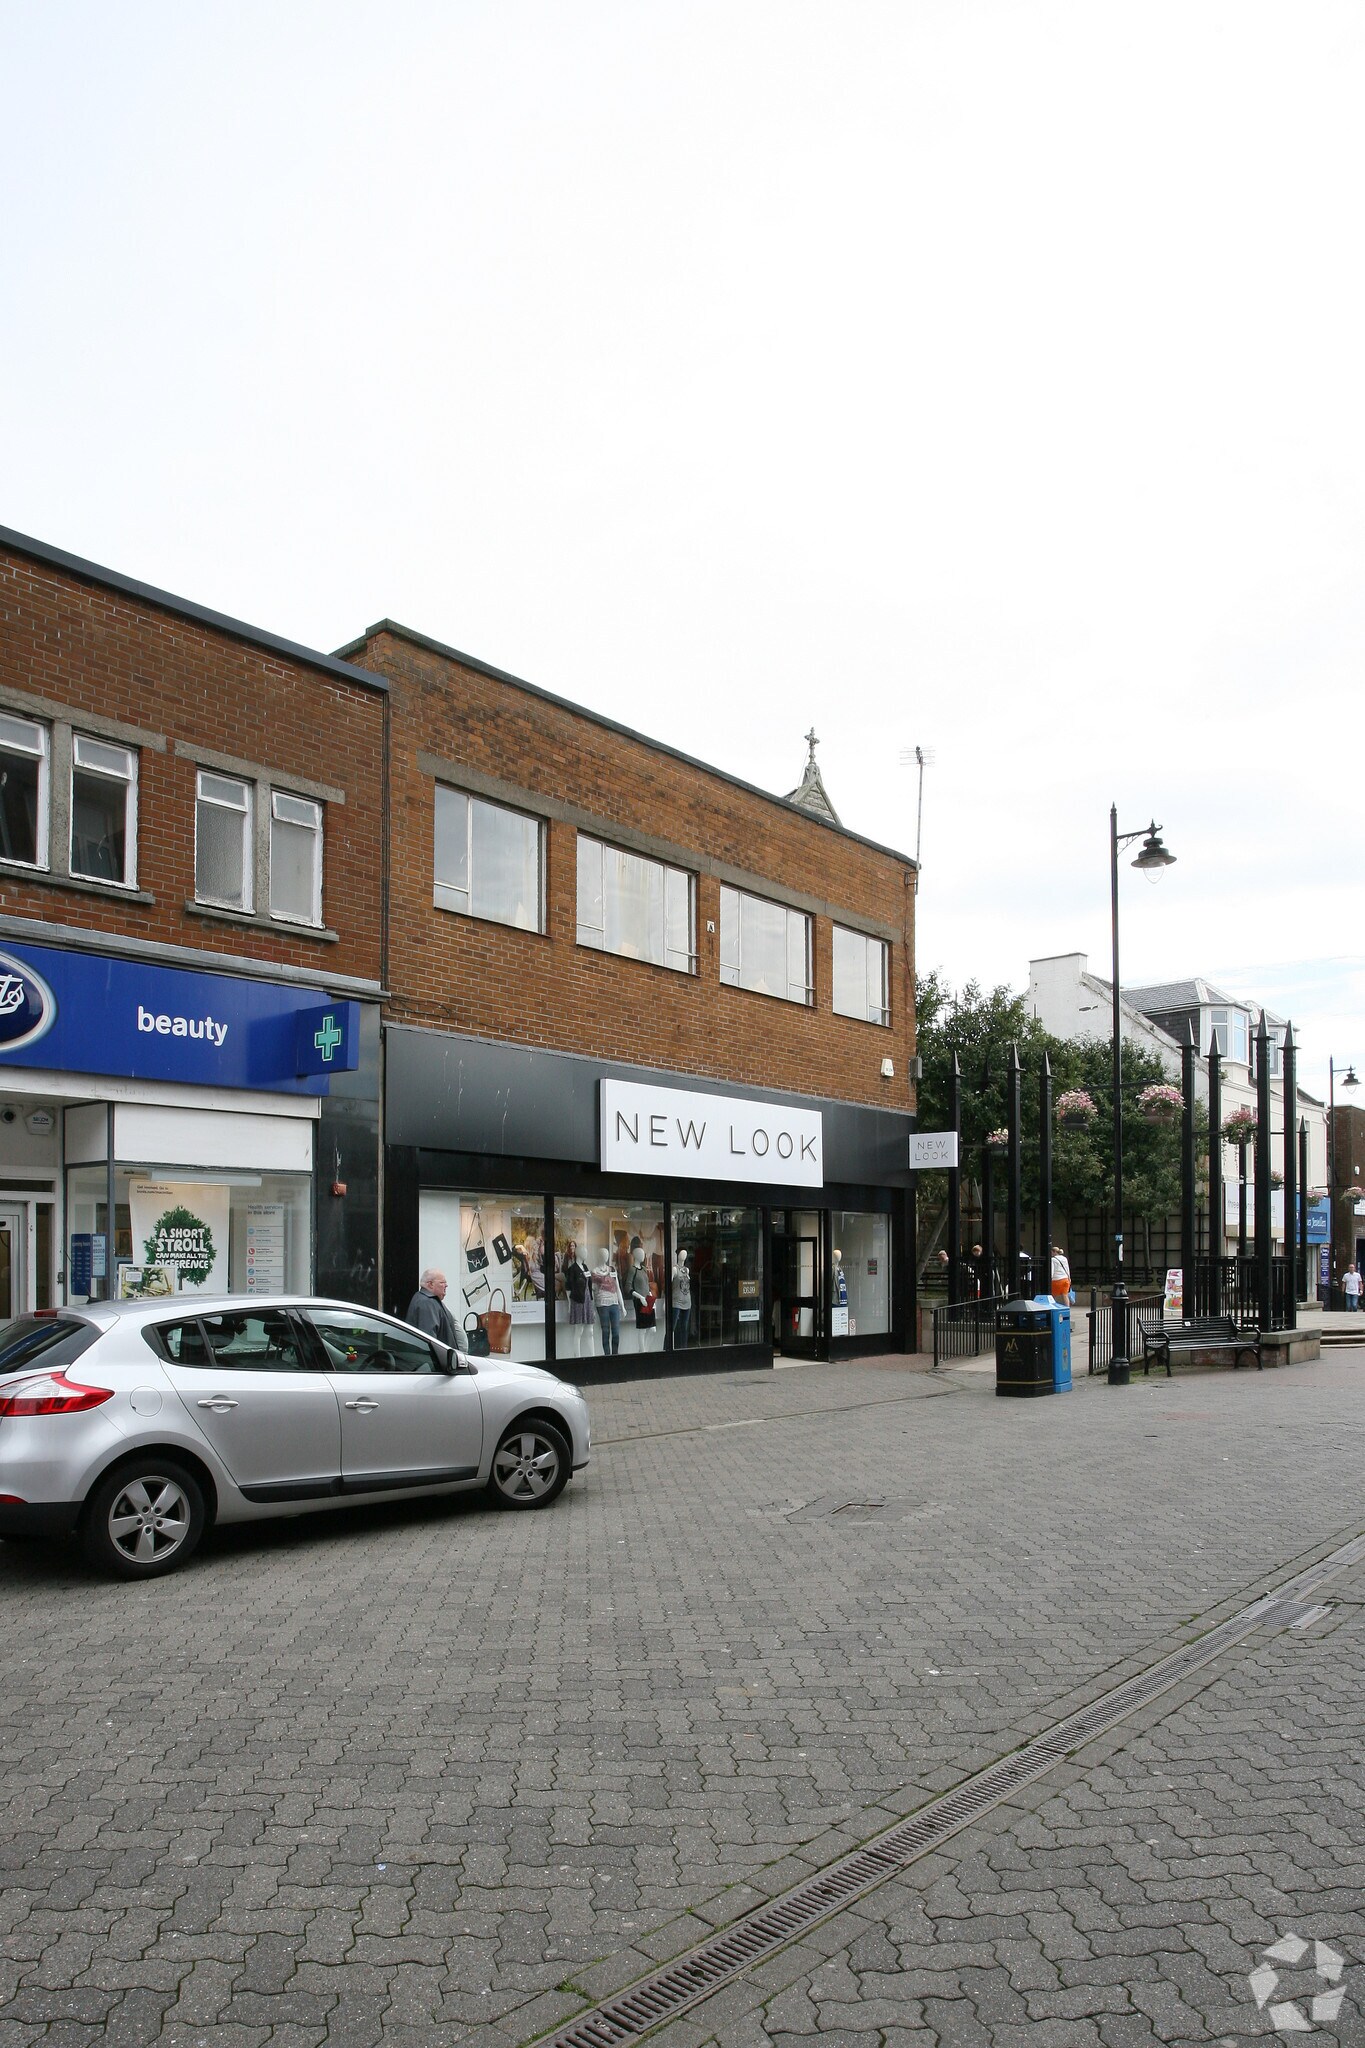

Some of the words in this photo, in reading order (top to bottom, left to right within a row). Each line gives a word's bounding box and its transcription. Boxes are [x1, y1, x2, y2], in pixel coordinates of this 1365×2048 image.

[137, 1005, 228, 1047] beauty
[616, 1110, 706, 1150] NEW
[730, 1124, 817, 1162] LOOK
[917, 1140, 946, 1150] NEW
[914, 1151, 949, 1161] LOOK
[160, 1228, 167, 1238] A
[169, 1228, 205, 1239] SHORT
[156, 1238, 209, 1252] STROLL
